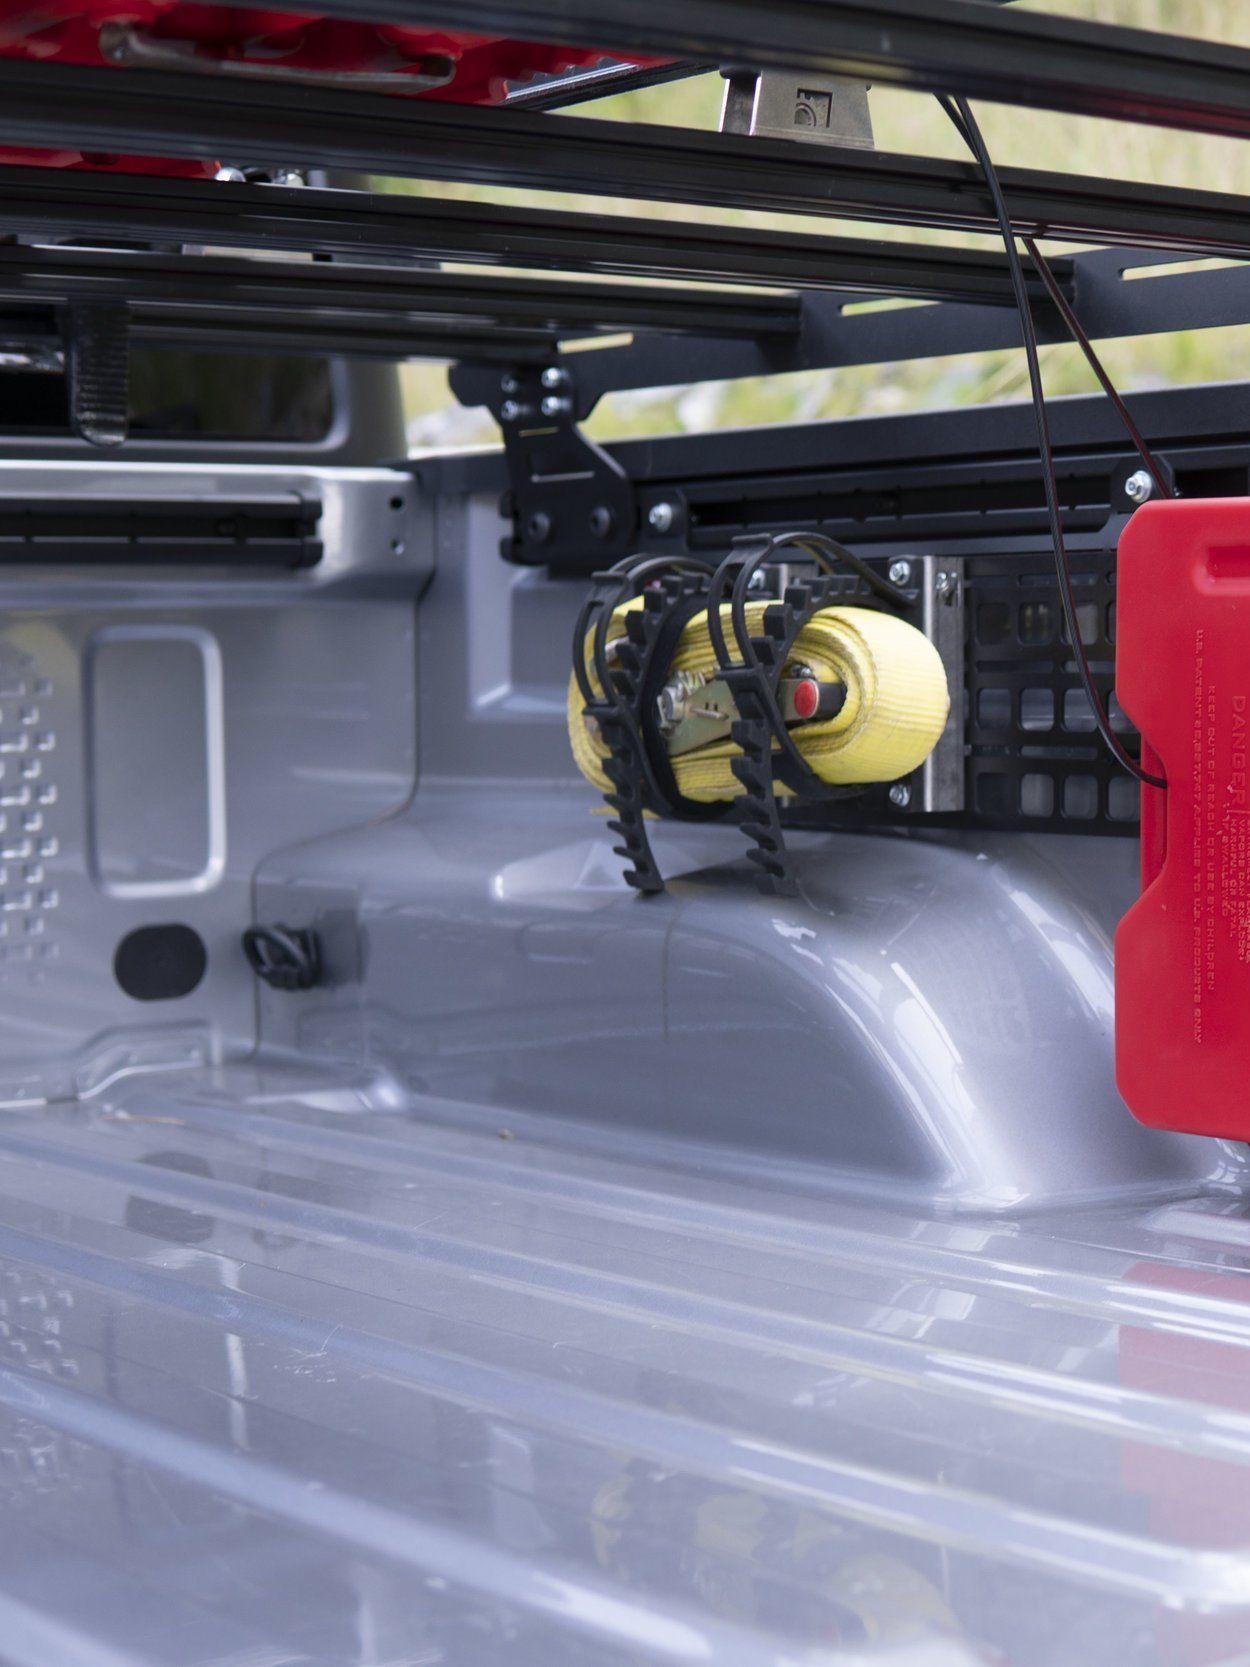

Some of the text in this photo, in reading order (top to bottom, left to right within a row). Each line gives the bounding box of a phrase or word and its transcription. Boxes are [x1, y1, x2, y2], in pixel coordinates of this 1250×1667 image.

[1194, 657, 1204, 717] PATENT
[1231, 695, 1247, 805] DANGER
[1194, 804, 1202, 867] APPLIES
[1206, 685, 1215, 991] KEEP OUT OF REACH OR USE BY CHILDREN
[1194, 873, 1201, 892] TO
[1230, 879, 1237, 896] OR
[1193, 927, 1201, 1003] PRODUCTS
[1194, 1008, 1202, 1044] ONLY
